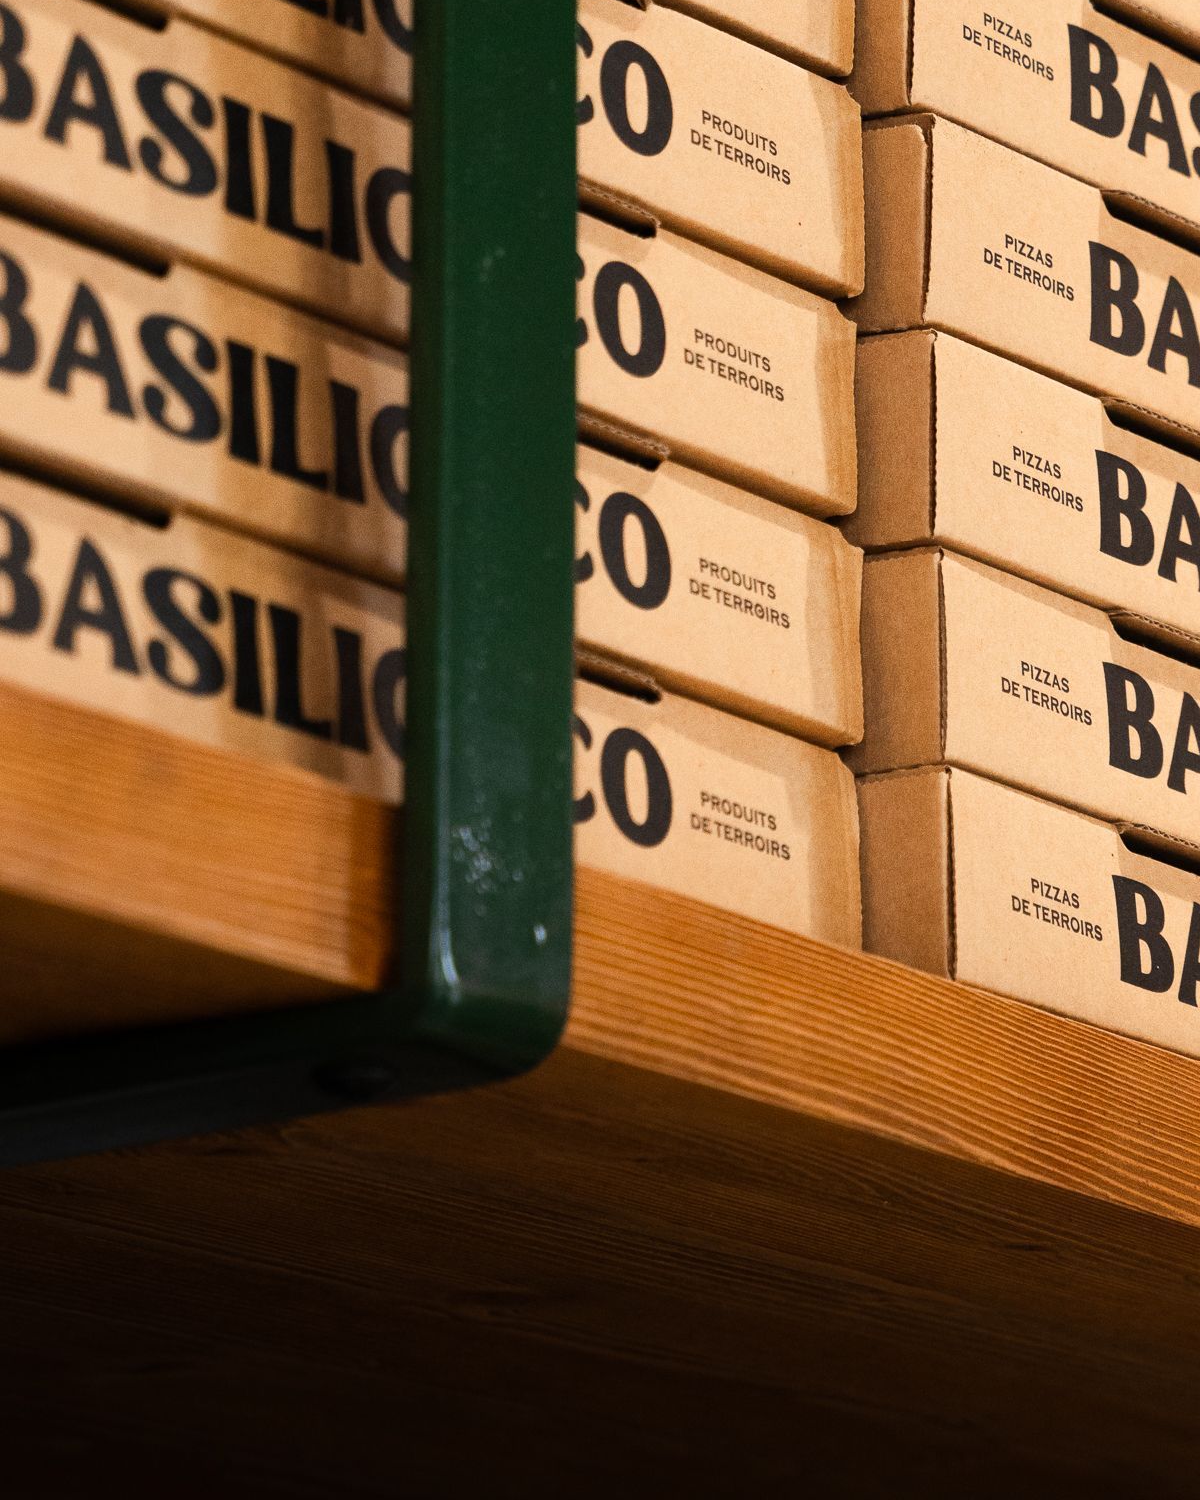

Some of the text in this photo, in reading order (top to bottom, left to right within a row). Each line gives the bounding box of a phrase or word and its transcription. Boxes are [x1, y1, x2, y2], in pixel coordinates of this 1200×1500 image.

[963, 25, 1054, 81] DE TERROIRS
[984, 13, 1032, 48] PIZZAS
[702, 110, 777, 156] PRODUITS
[691, 129, 790, 185] DE TERROIRS
[1005, 234, 1053, 268] PIZZAS
[984, 248, 1074, 301] DE TERROIRS
[694, 329, 770, 372] PRODUITS
[684, 348, 784, 401] DE TERROIRS
[1013, 446, 1061, 479] PIZZAS
[992, 460, 1083, 512] DE TERROIRS
[700, 558, 776, 600] PRODUITS
[689, 579, 790, 628] DE TERROIRS
[1021, 661, 1069, 693] PIZZAS
[1001, 677, 1092, 726] DE TERROIRS
[700, 792, 776, 831] PRODUITS
[691, 814, 790, 860] DE TERROIRS
[1031, 878, 1080, 909] PIZZAS
[1011, 895, 1102, 941] DE TERROIRS
